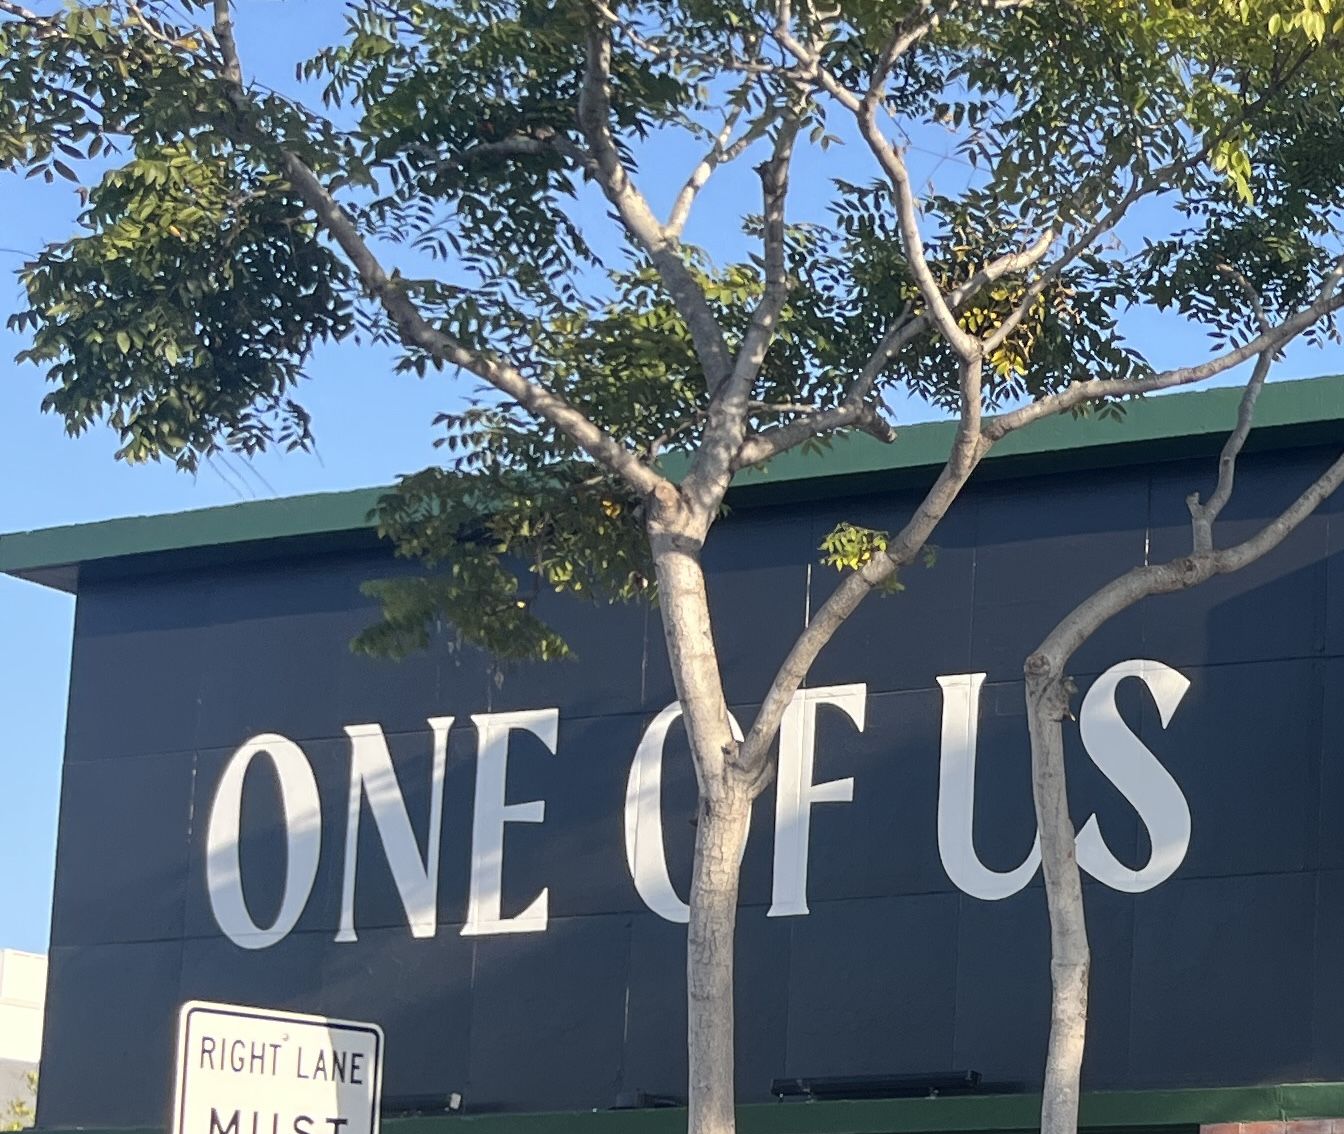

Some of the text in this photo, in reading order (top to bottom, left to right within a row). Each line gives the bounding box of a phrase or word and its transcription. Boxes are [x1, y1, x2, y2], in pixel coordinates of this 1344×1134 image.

[207, 708, 559, 948] ONE
[936, 659, 1192, 900] US
[200, 1037, 365, 1087] RIGHT LANE
